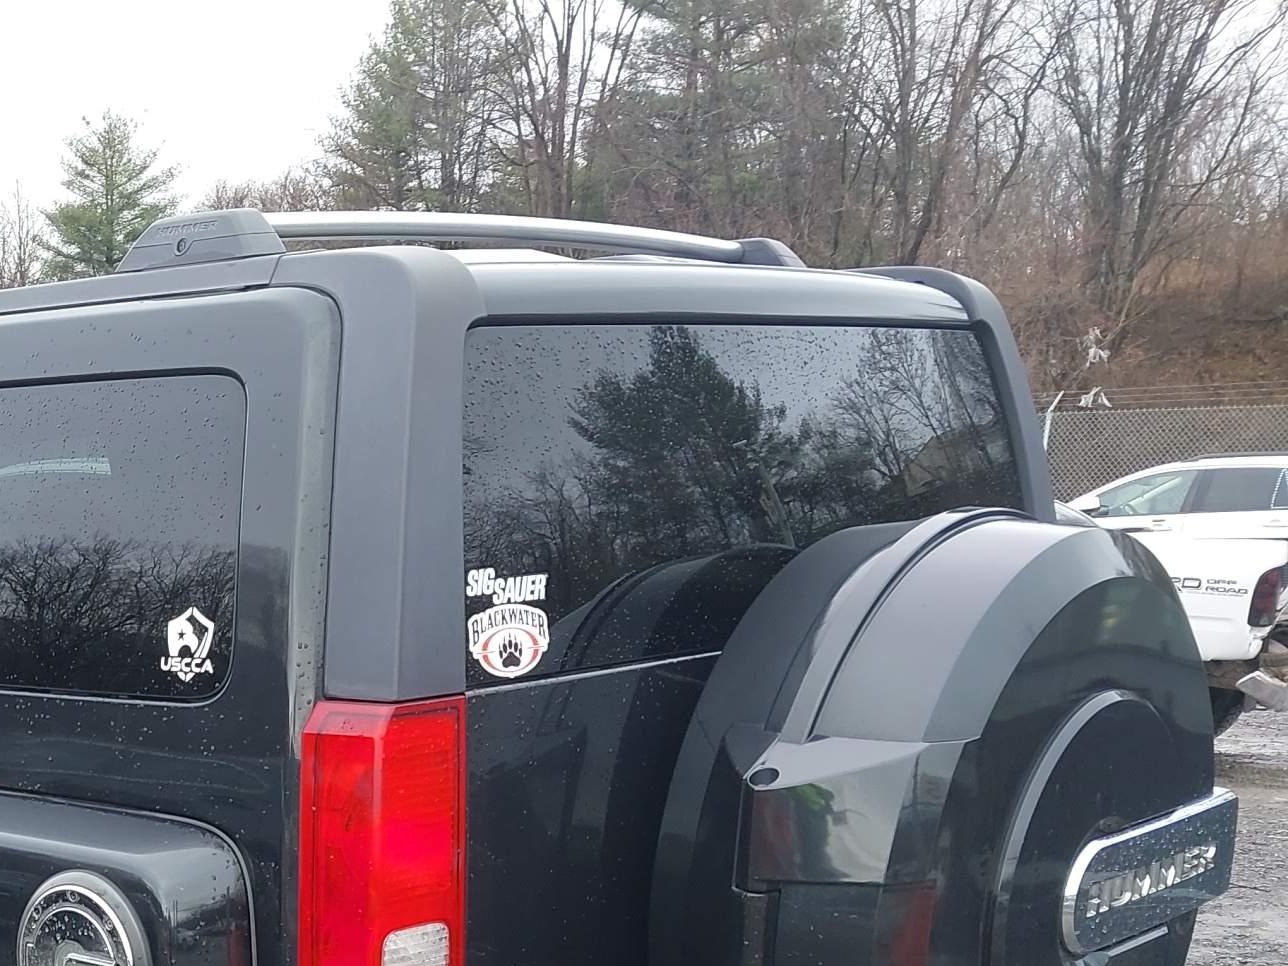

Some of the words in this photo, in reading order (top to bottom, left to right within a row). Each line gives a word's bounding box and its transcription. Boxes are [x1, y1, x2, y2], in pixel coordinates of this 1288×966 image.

[466, 567, 496, 597] SIG
[492, 574, 547, 605] SAUER
[1205, 586, 1249, 595] ROAD
[471, 607, 547, 647] BLACKWATER
[160, 656, 214, 674] USCCA
[1086, 845, 1217, 918] HUMMER
